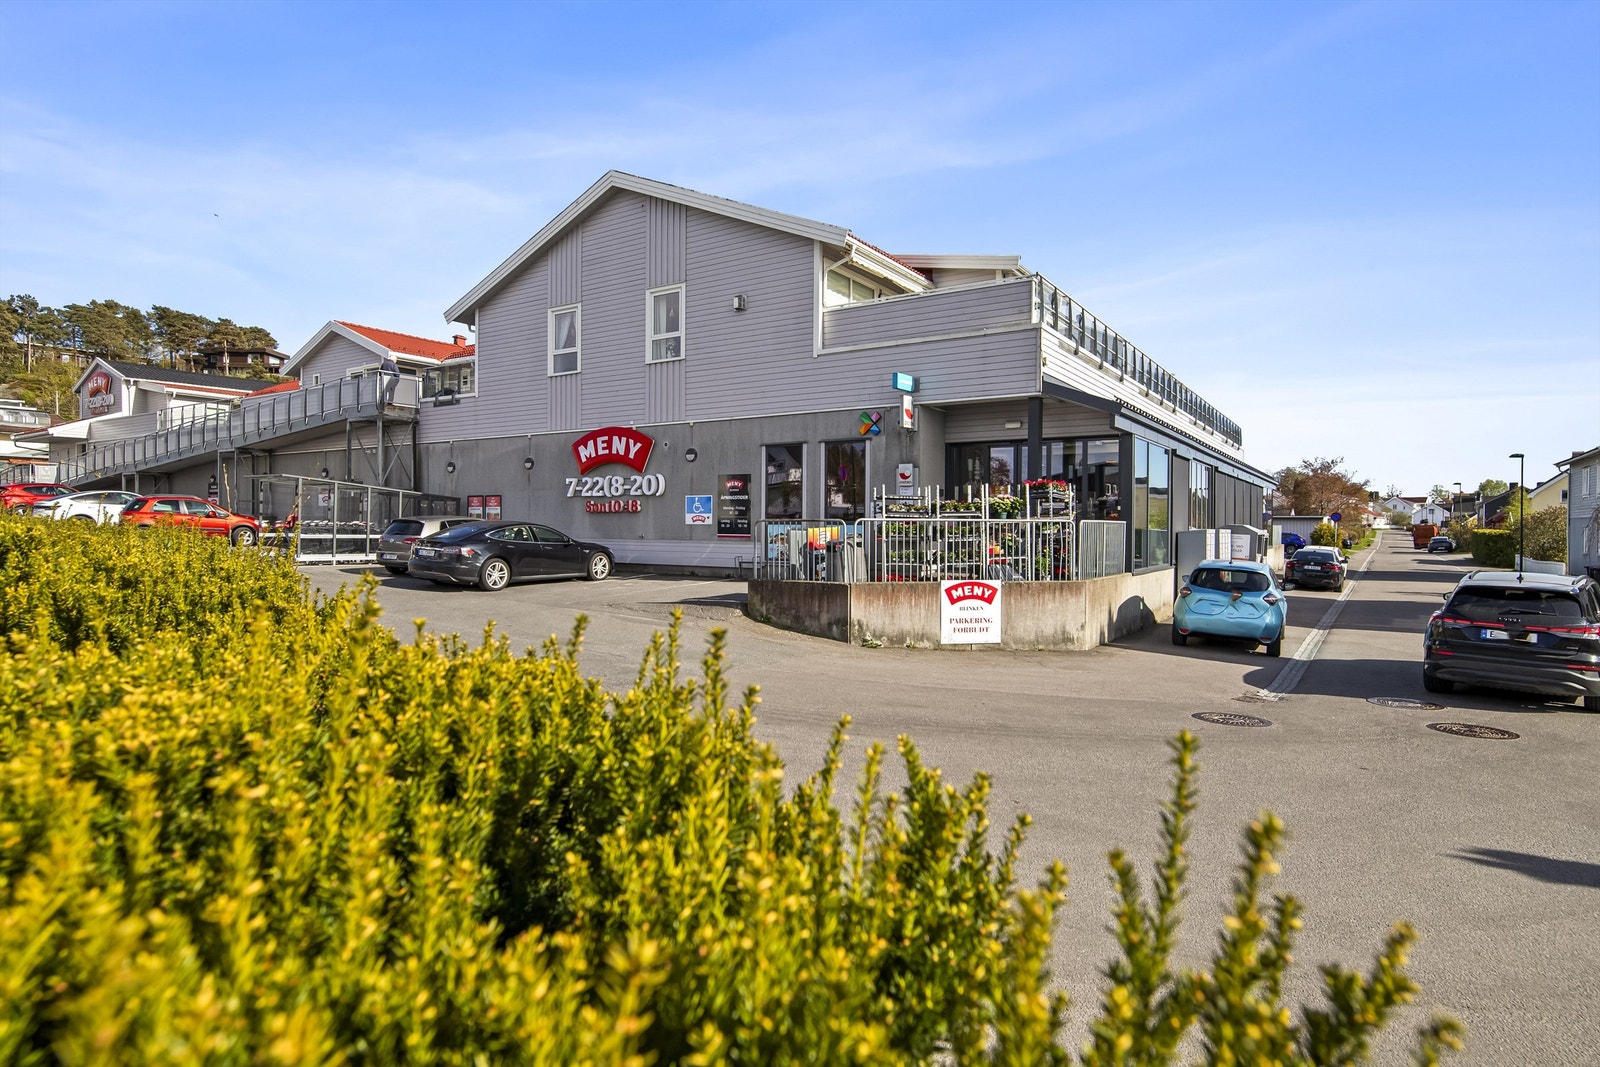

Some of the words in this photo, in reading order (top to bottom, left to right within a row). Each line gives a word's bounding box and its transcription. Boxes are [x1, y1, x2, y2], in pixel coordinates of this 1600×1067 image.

[88, 376, 106, 389] MENY
[577, 435, 642, 463] MENY
[565, 473, 666, 498] 7-22(8-20)
[950, 586, 992, 600] MENY
